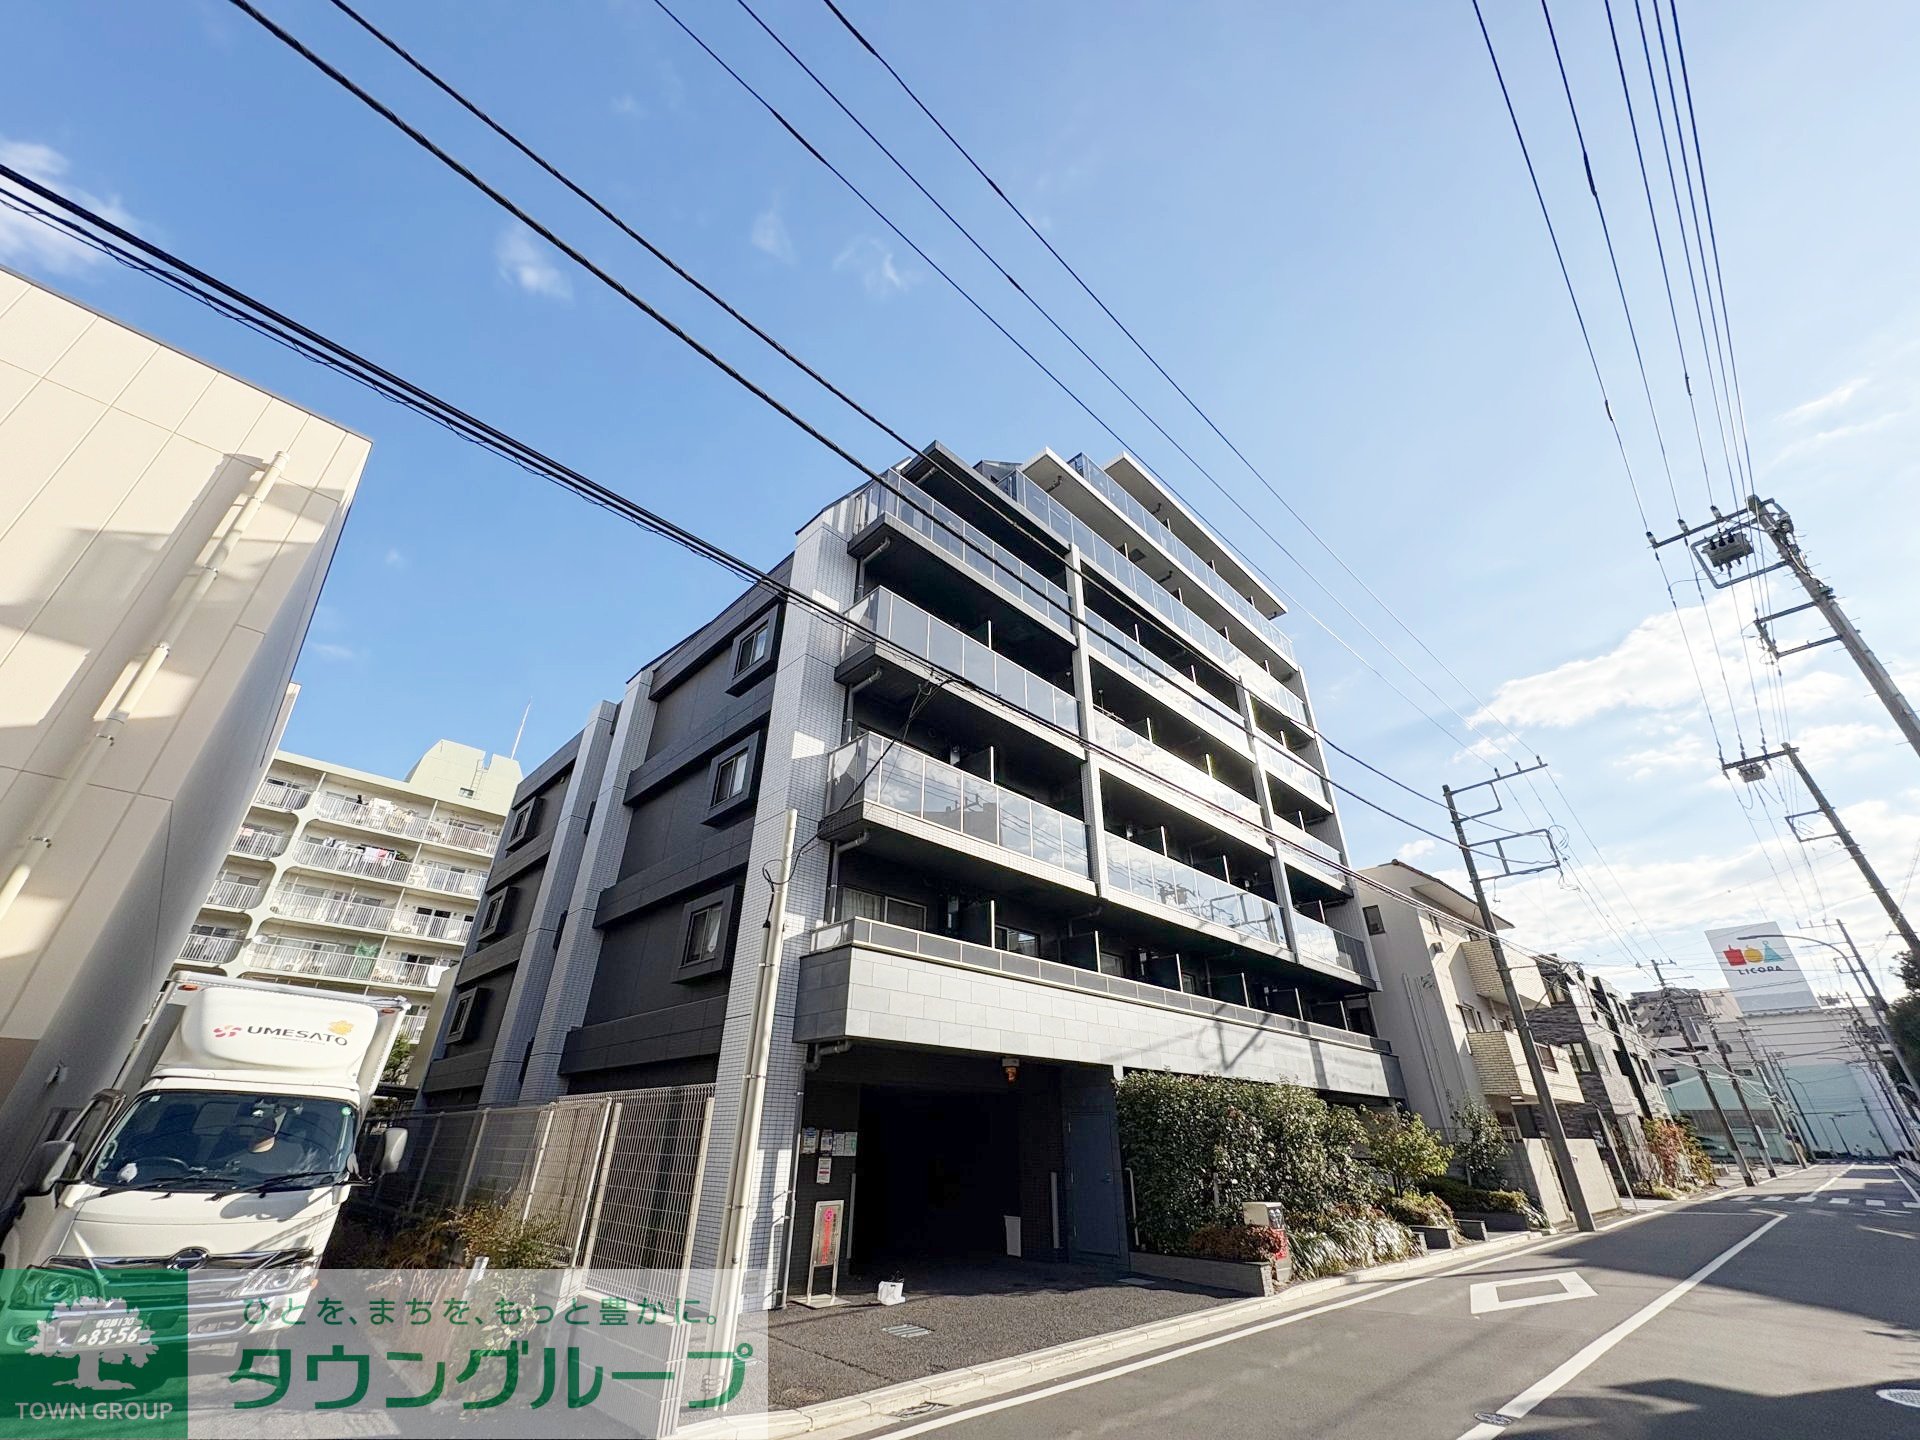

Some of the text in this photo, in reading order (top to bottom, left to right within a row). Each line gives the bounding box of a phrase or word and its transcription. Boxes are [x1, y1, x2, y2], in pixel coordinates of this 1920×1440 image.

[1738, 965, 1784, 975] LICOPA
[247, 1025, 348, 1046] UMESATO
[87, 1325, 142, 1346] 83-56
